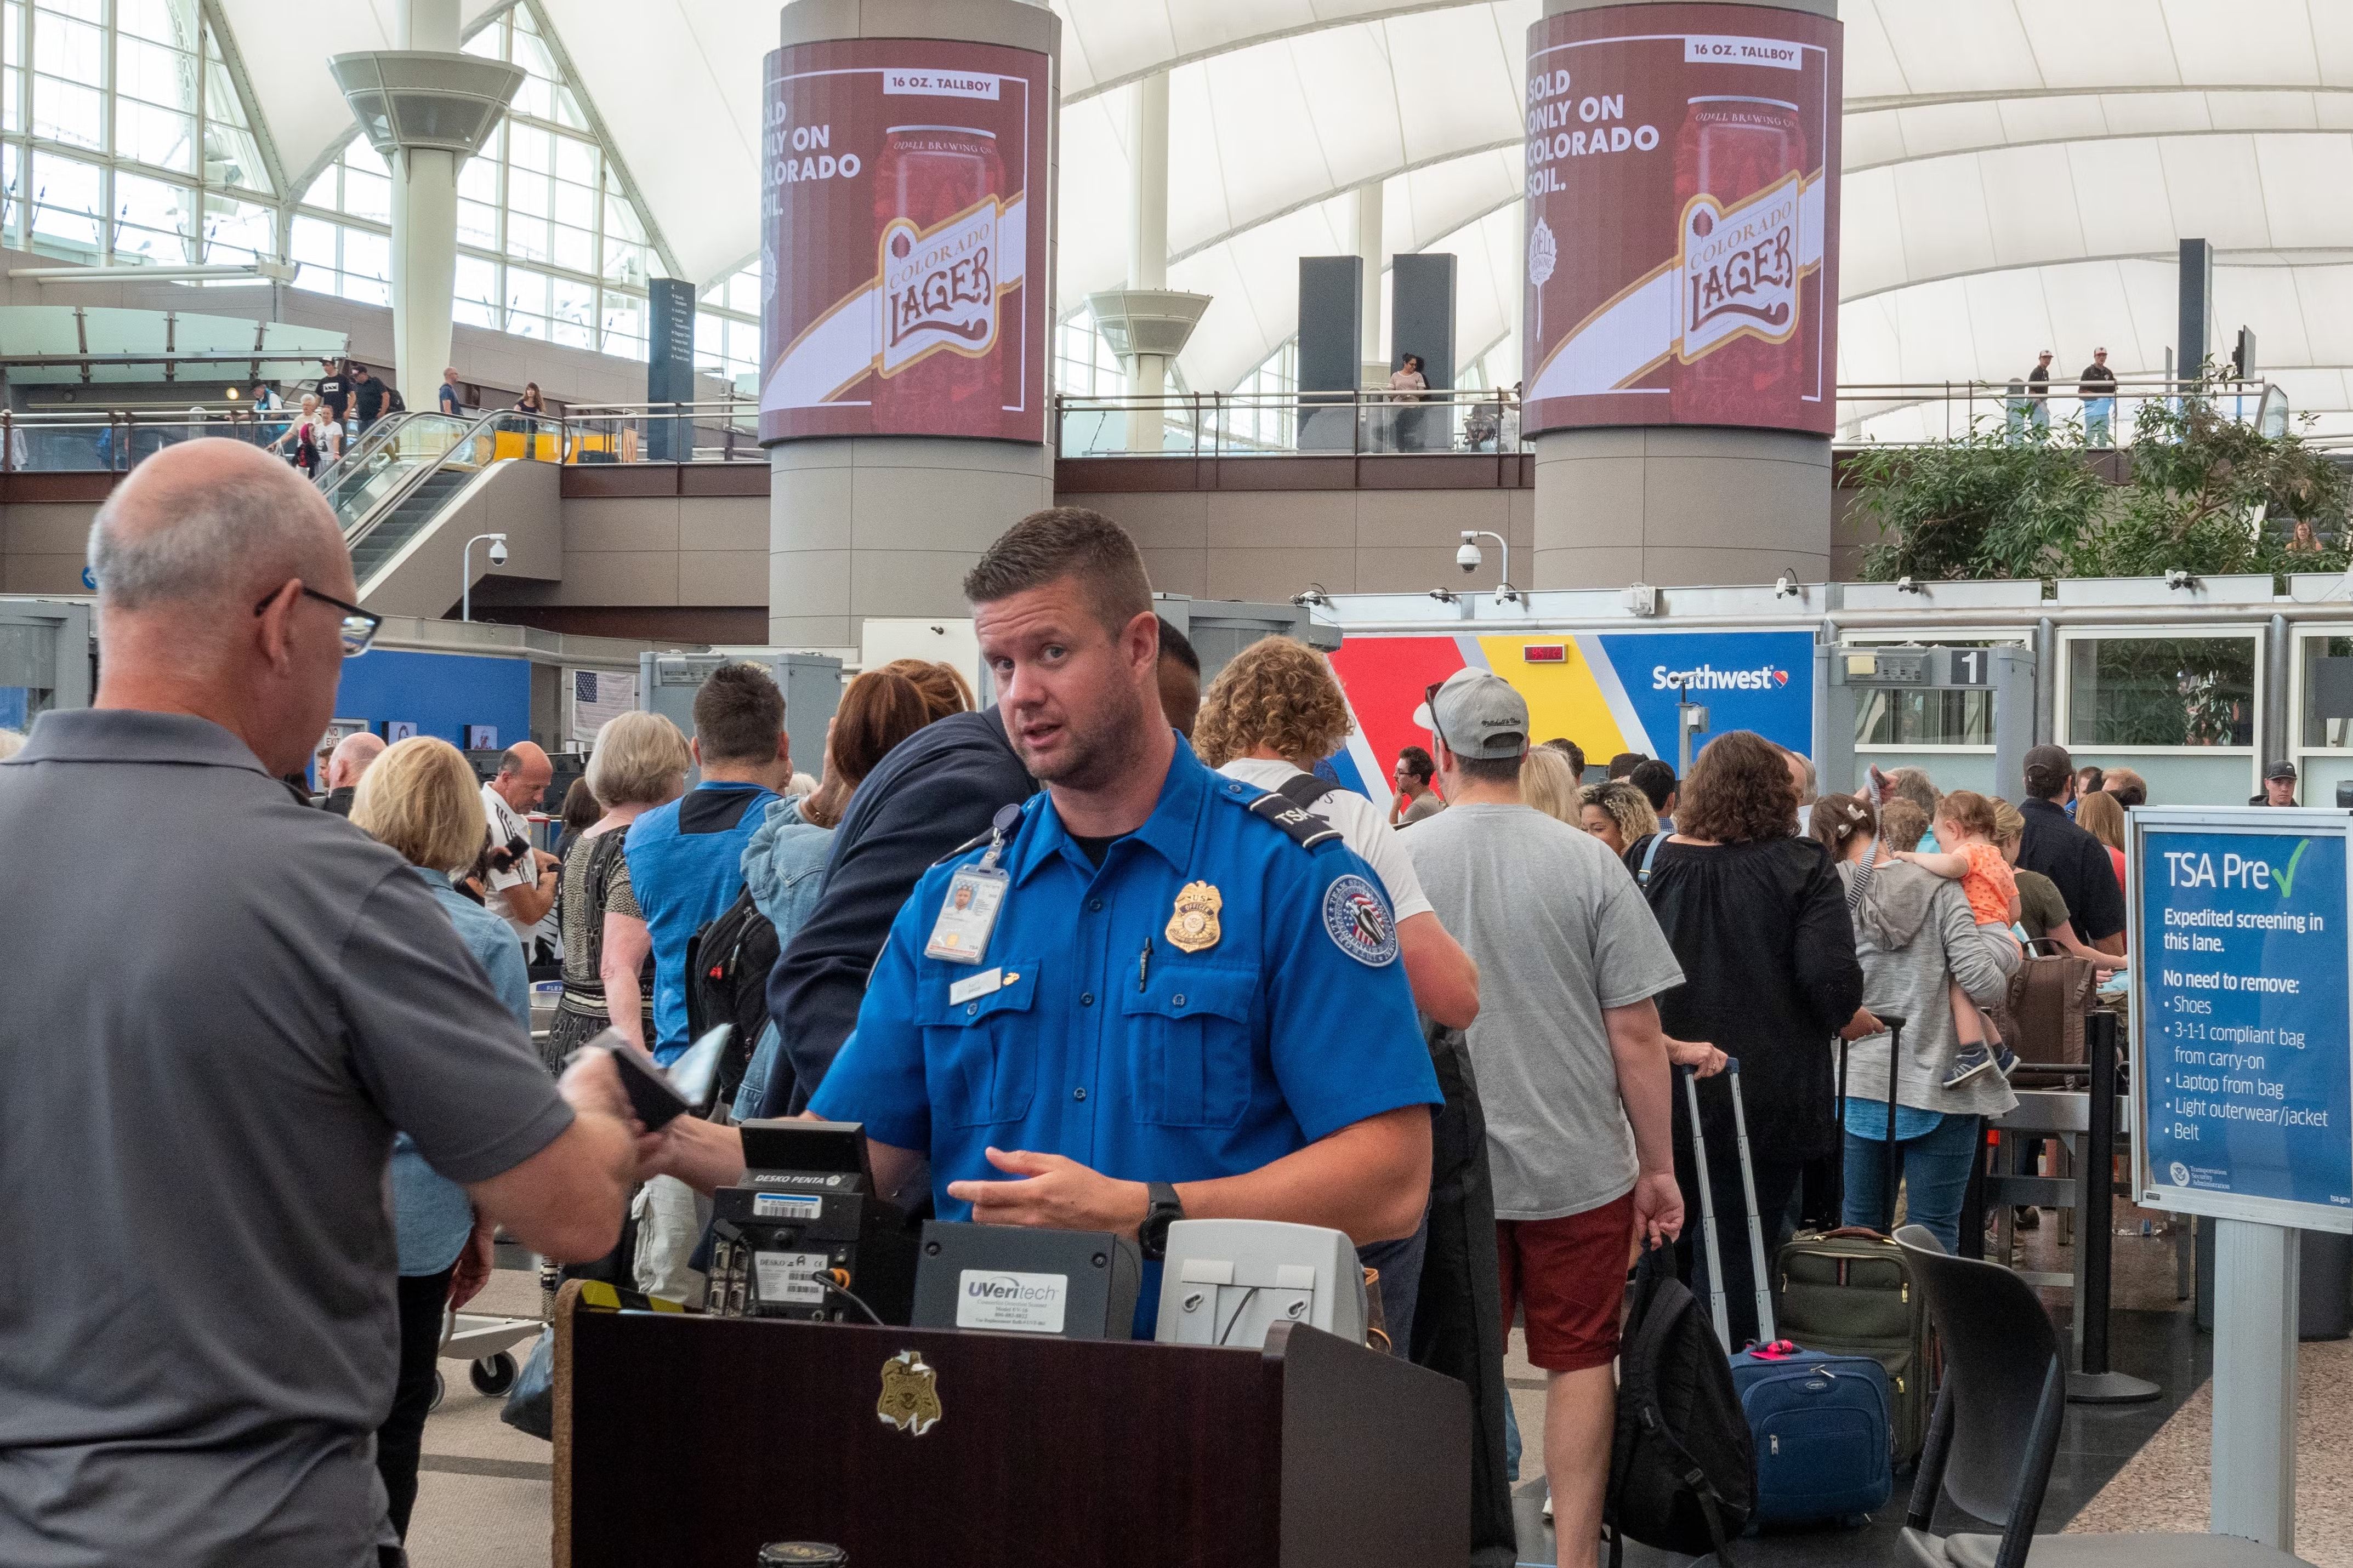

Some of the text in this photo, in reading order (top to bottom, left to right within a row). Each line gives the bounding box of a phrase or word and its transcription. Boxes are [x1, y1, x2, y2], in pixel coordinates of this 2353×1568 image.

[1694, 44, 1794, 61] 16 OZ. TALLBOY
[893, 77, 991, 92] 16 OZ. TALLBOY
[1528, 70, 1570, 104] SOLD
[764, 101, 786, 130] OLD
[1528, 94, 1623, 135] ONLY ON
[1695, 112, 1729, 122] ODELL
[1732, 113, 1781, 126] BREWING
[764, 124, 829, 159] NLY ON
[893, 141, 924, 150] ODELL
[928, 141, 977, 152] BREWING
[1528, 125, 1659, 167] COLORADO
[763, 153, 861, 191] OLORADO
[1527, 167, 1566, 199] SOIL.
[763, 193, 783, 220] OIL.
[1691, 201, 1792, 270] COLORADO
[889, 224, 989, 289] COLORADO
[1690, 225, 1793, 332] LAGER
[890, 247, 991, 347] LAGER
[1653, 664, 1772, 689] Southwest
[1962, 652, 1977, 683] 1
[329, 727, 338, 736] NO
[1275, 807, 1315, 825] TSA
[2164, 852, 2269, 890] TSA Pre
[1185, 903, 1210, 913] OFFICER
[2164, 908, 2323, 933] Expedited screening in
[2164, 933, 2224, 952] this lane.
[2164, 970, 2299, 993] No need to remove:
[2174, 996, 2211, 1014] Shoes
[2175, 1022, 2305, 1049] 3-1-1 compliant bag
[2175, 1046, 2264, 1070] from carry-on
[2175, 1073, 2284, 1100] Laptop from bag
[2175, 1097, 2328, 1127] Light outerwear/jacket
[2174, 1122, 2199, 1141] Belt
[2330, 1194, 2350, 1204] tsa.gov
[969, 1281, 1055, 1301] UVeritech
